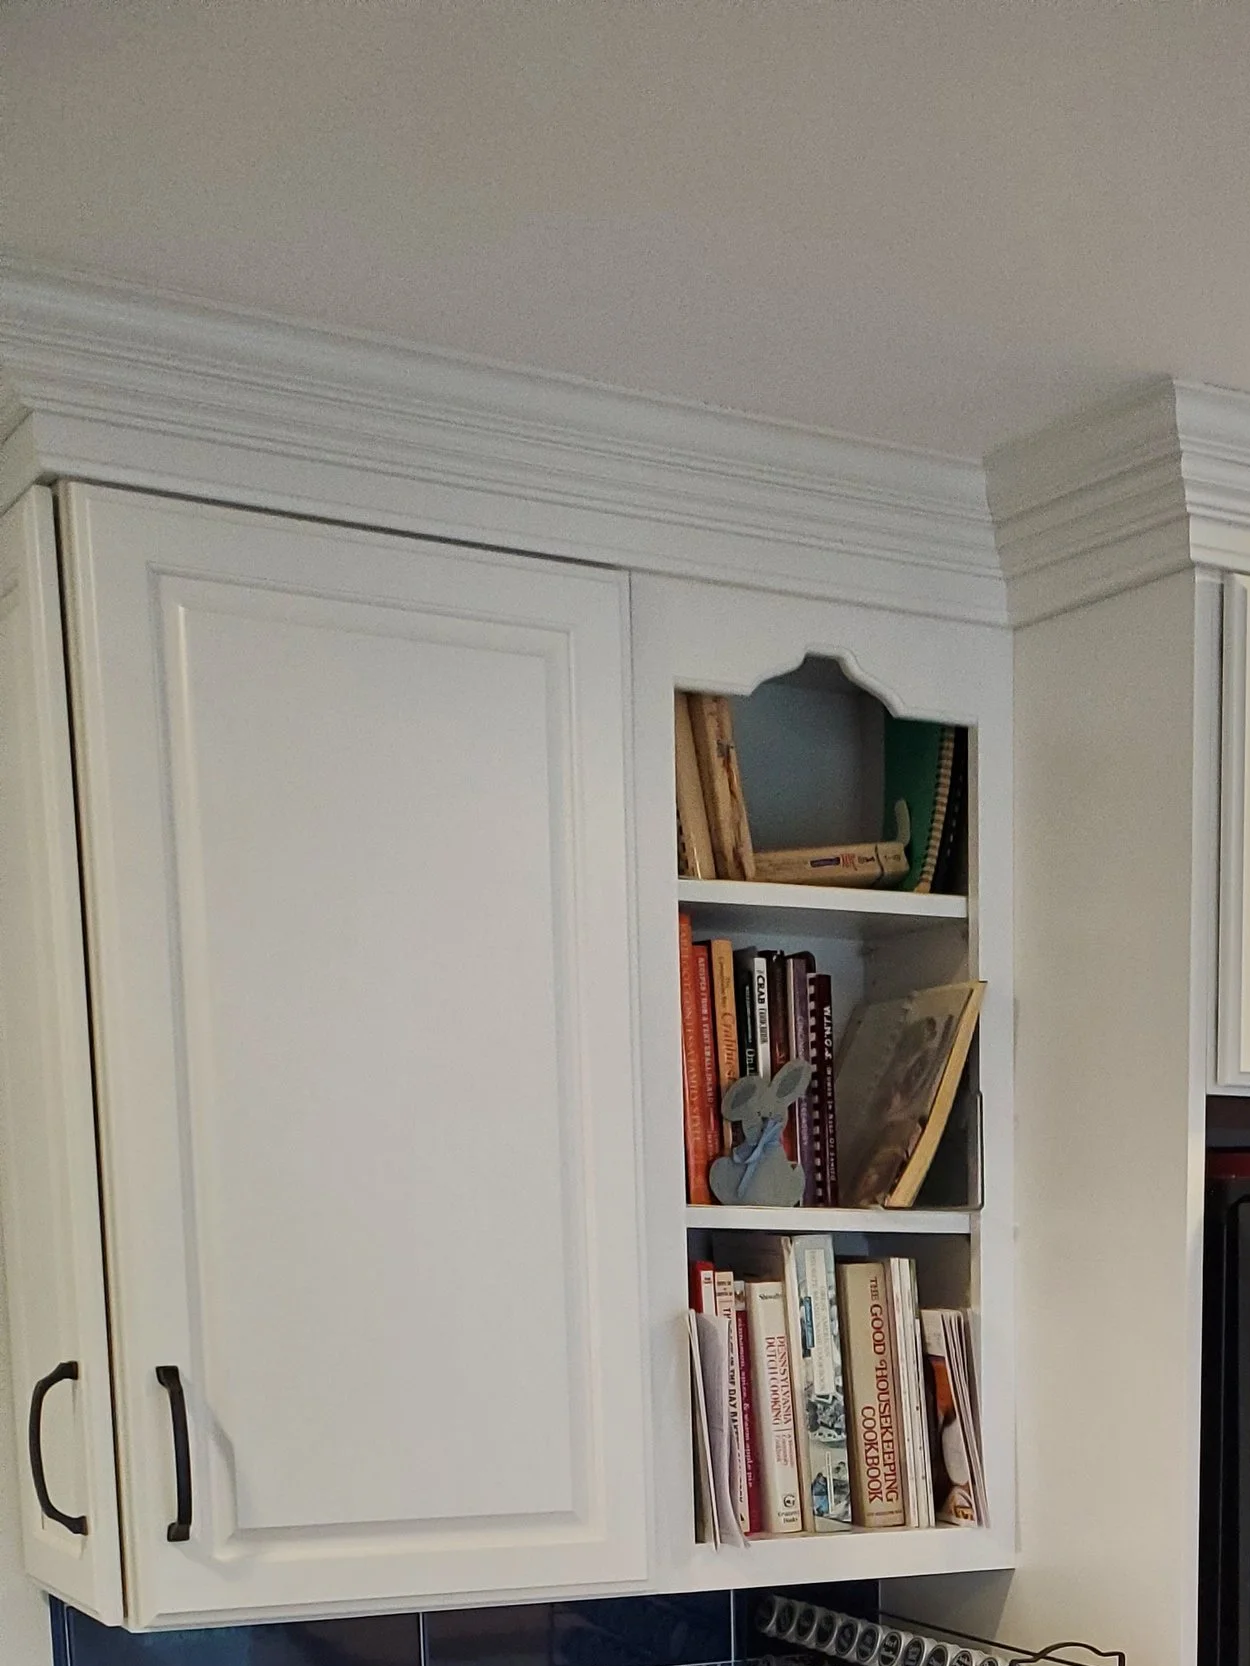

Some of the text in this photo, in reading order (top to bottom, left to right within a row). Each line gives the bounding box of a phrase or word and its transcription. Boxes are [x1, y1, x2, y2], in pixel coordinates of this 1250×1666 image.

[756, 974, 766, 1004] CRAB
[869, 1276, 880, 1301] THE
[870, 1303, 886, 1355] GOOD
[728, 1388, 738, 1409] DAY
[765, 1336, 781, 1426] DUTCH COOKING
[776, 1335, 792, 1425] PENNSYLVANIA
[861, 1405, 883, 1504] COOKBOOK
[875, 1359, 899, 1503] HOUSEKEEPING
